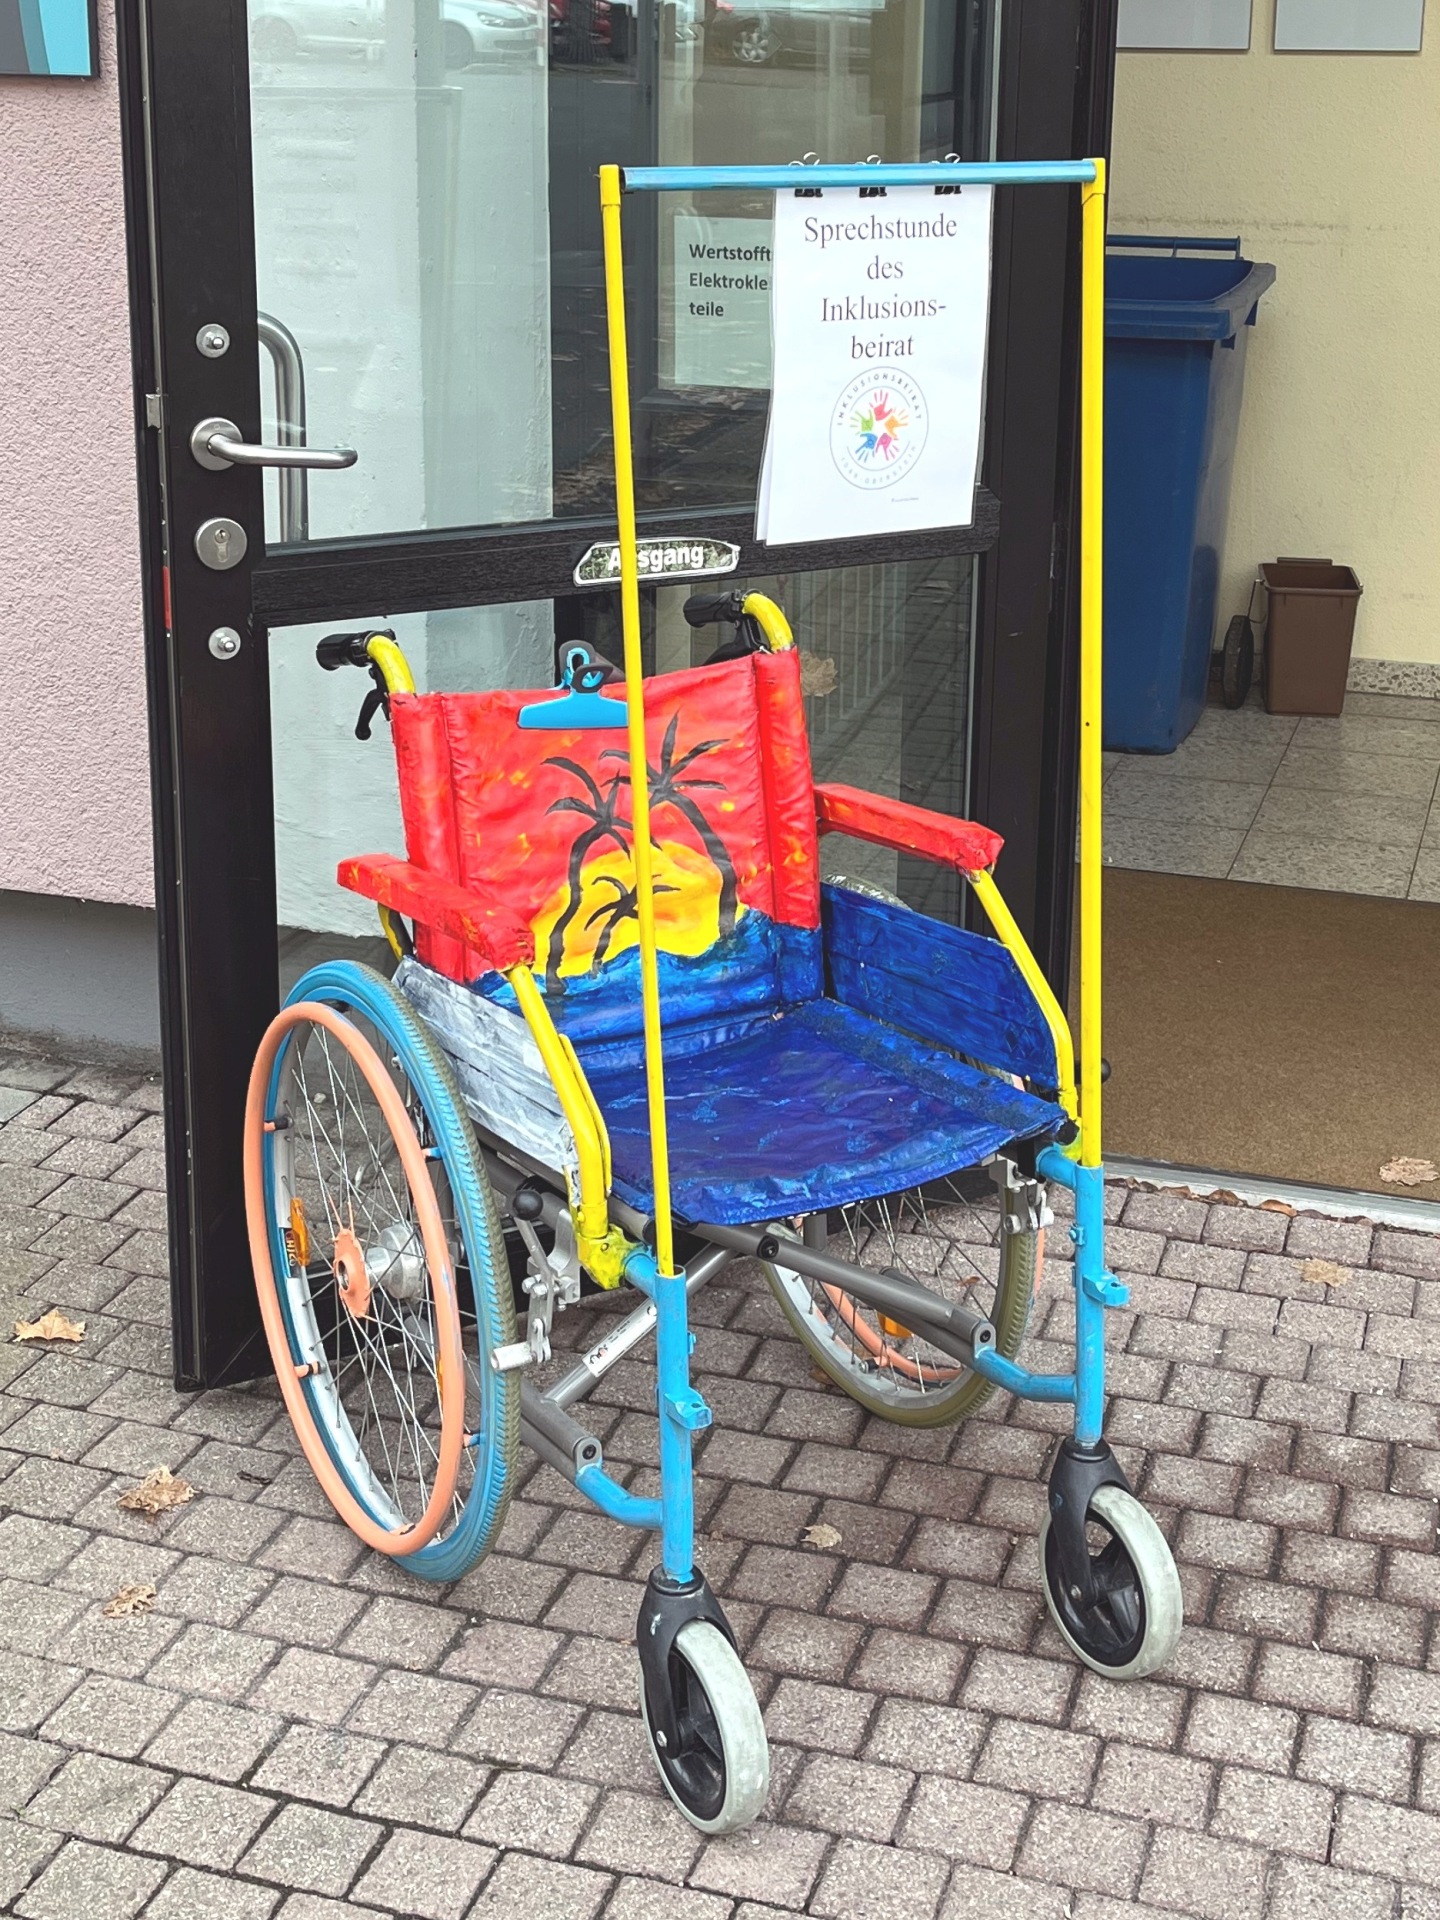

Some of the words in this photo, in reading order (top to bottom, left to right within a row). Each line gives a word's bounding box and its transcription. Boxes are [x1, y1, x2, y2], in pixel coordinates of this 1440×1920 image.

[804, 212, 958, 249] Sprechstunde
[688, 243, 772, 262] Wertstofft
[866, 255, 904, 280] des
[689, 271, 770, 291] Elektrokle
[688, 301, 724, 317] teile
[820, 293, 947, 322] Inklusions-
[850, 333, 915, 360] beirat
[607, 545, 704, 573] Asgang
